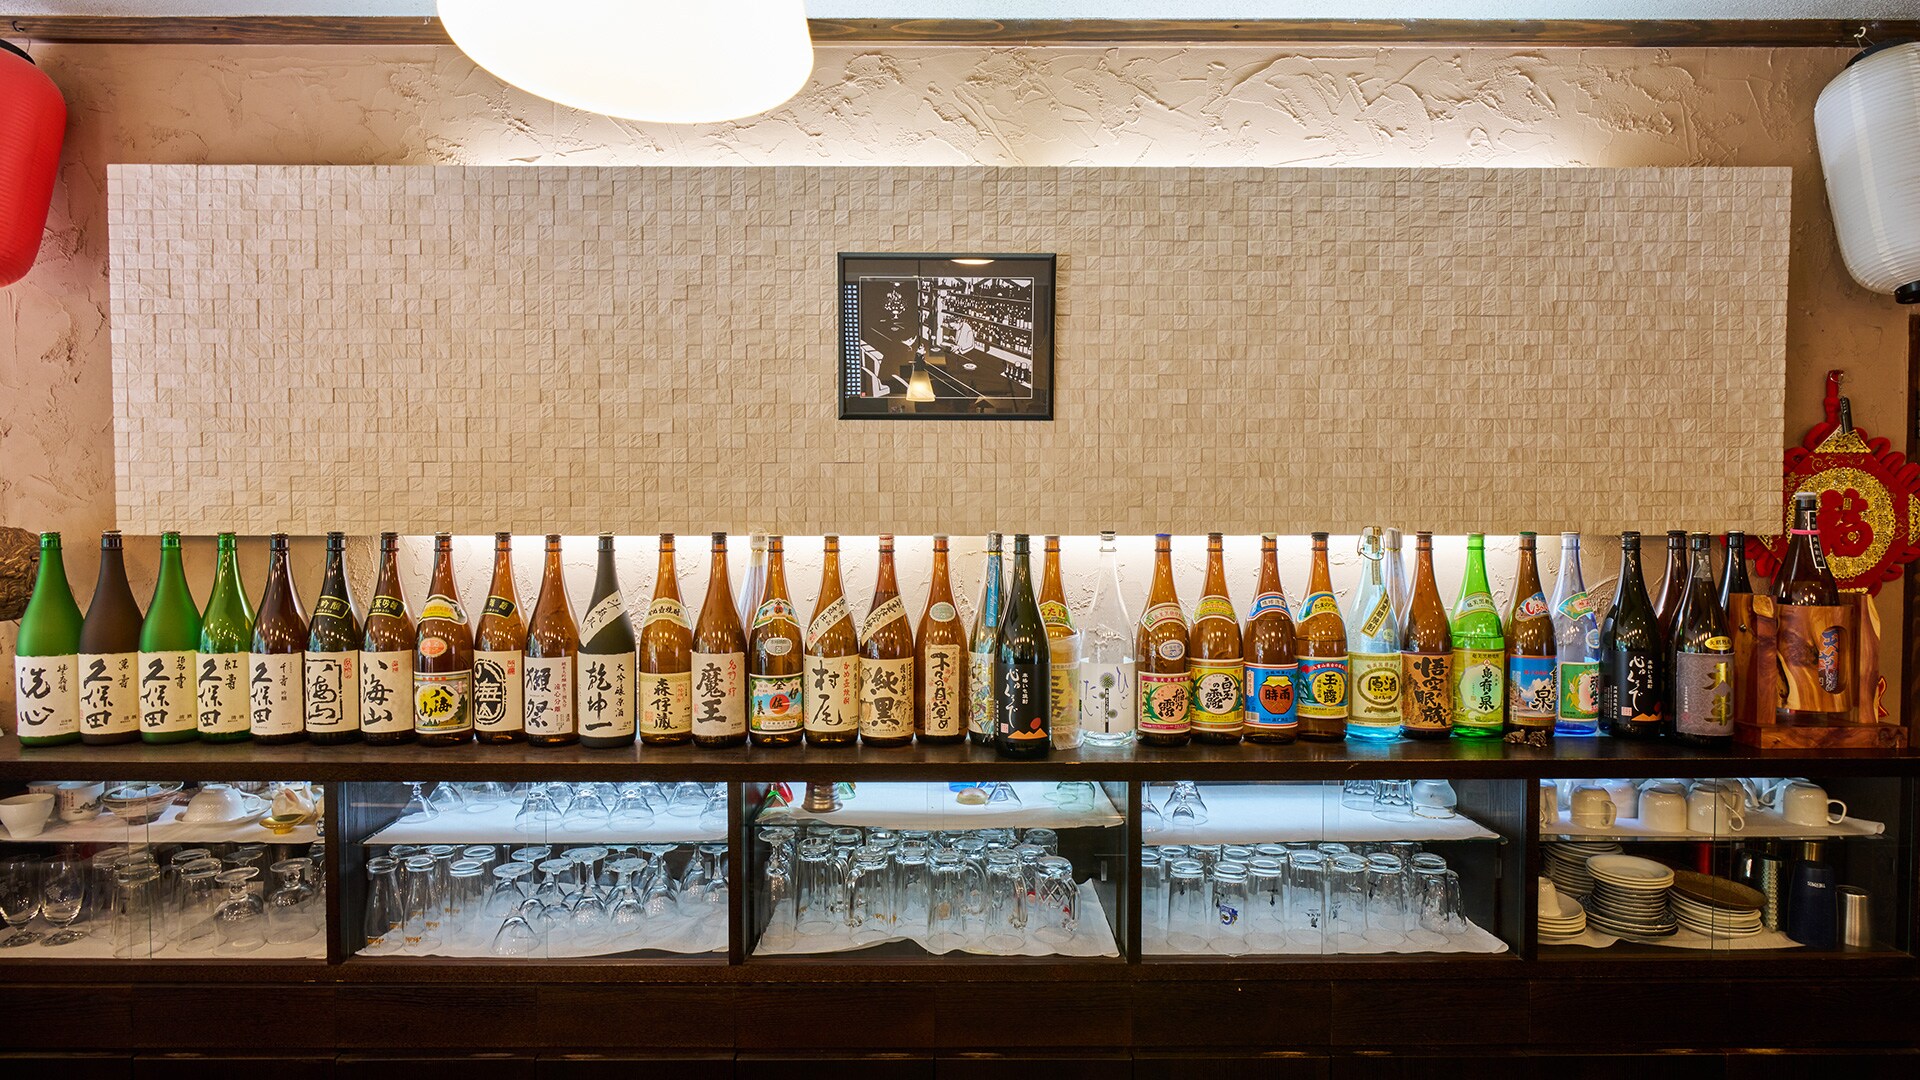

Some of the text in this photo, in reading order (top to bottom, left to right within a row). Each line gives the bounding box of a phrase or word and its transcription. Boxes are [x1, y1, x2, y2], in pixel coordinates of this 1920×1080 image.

[20, 667, 55, 726] 洗心
[81, 658, 114, 729] 久保田
[140, 657, 171, 727] 久保田
[198, 657, 223, 727] 久保田
[250, 661, 273, 723] 久保田
[363, 660, 394, 726] 八海山
[585, 661, 612, 731] 乾坤一
[696, 663, 727, 723] 魔王
[812, 660, 843, 726] 村尾
[870, 666, 901, 727] 純黒
[1264, 688, 1290, 701] 時雨
[1367, 675, 1397, 692] 原酒
